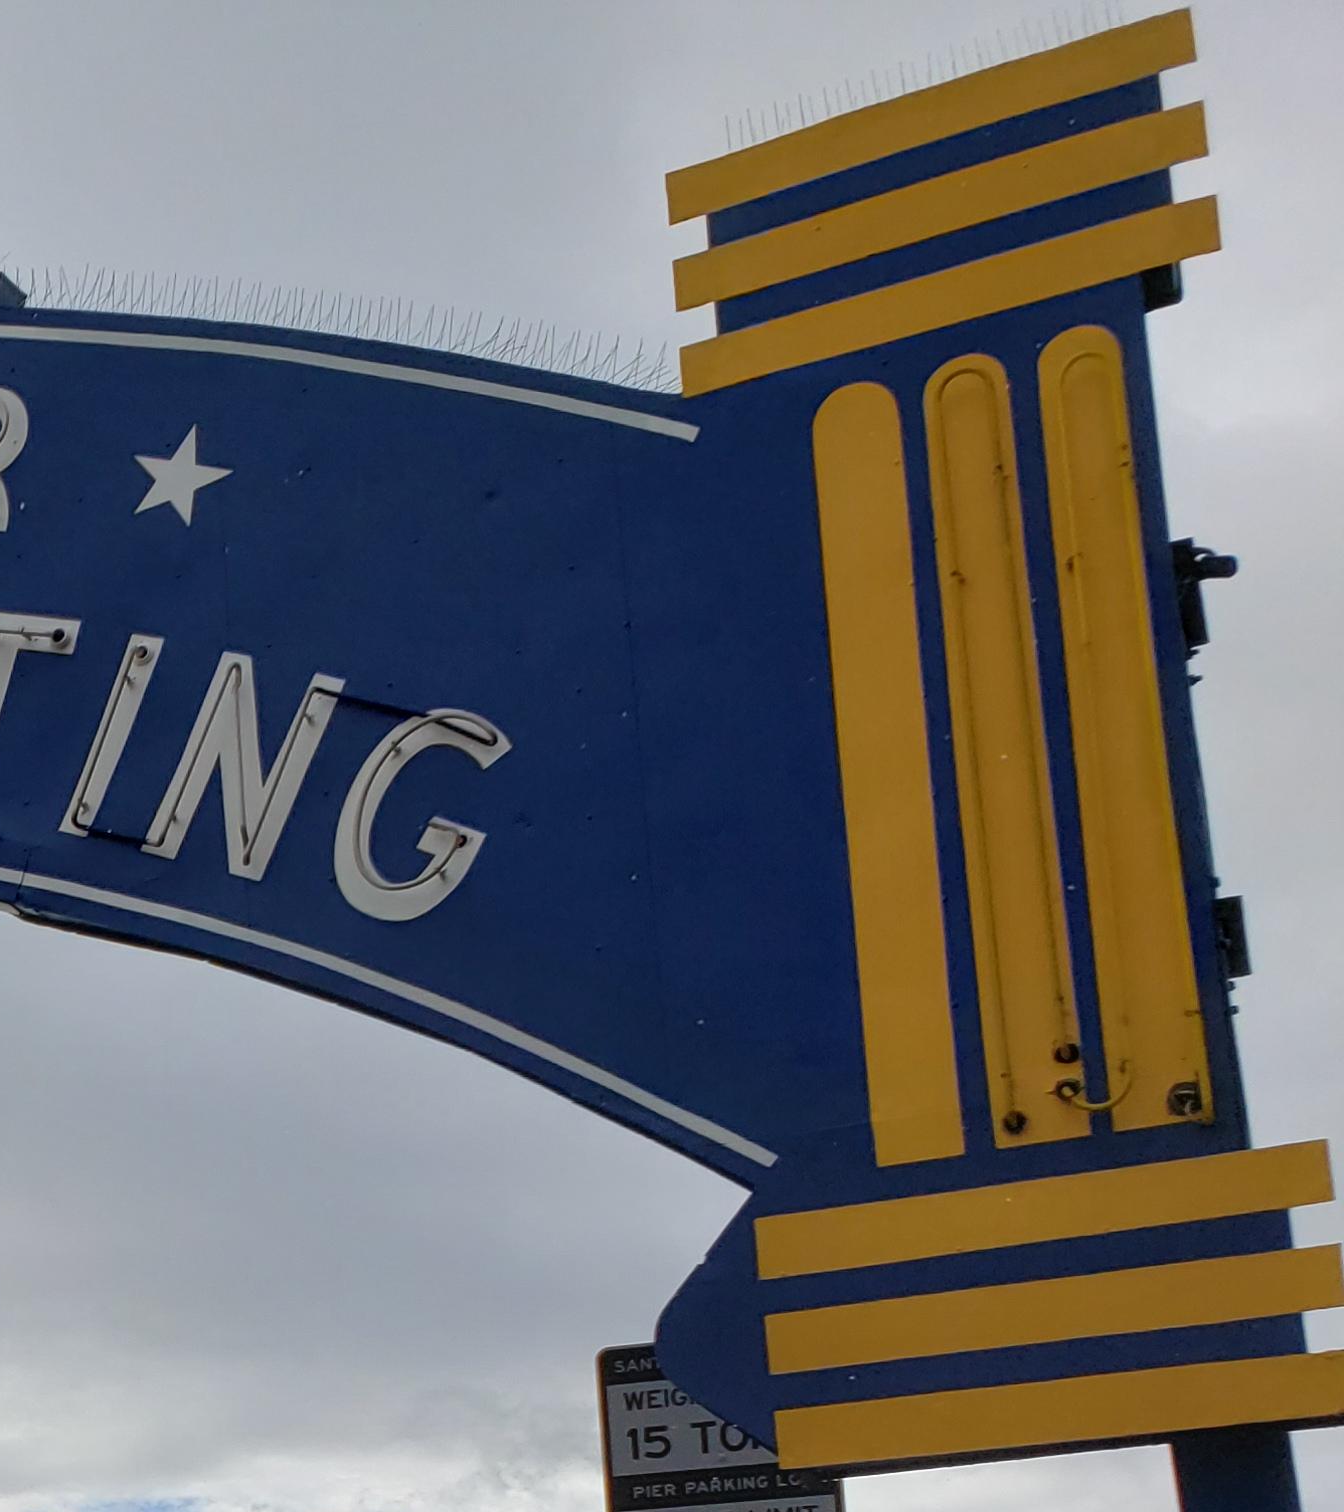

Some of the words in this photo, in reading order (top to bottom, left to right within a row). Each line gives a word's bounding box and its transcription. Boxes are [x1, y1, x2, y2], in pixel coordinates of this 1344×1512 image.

[626, 1425, 672, 1460] 15
[632, 1483, 677, 1499] PIER
[685, 1474, 768, 1495] PARKING
